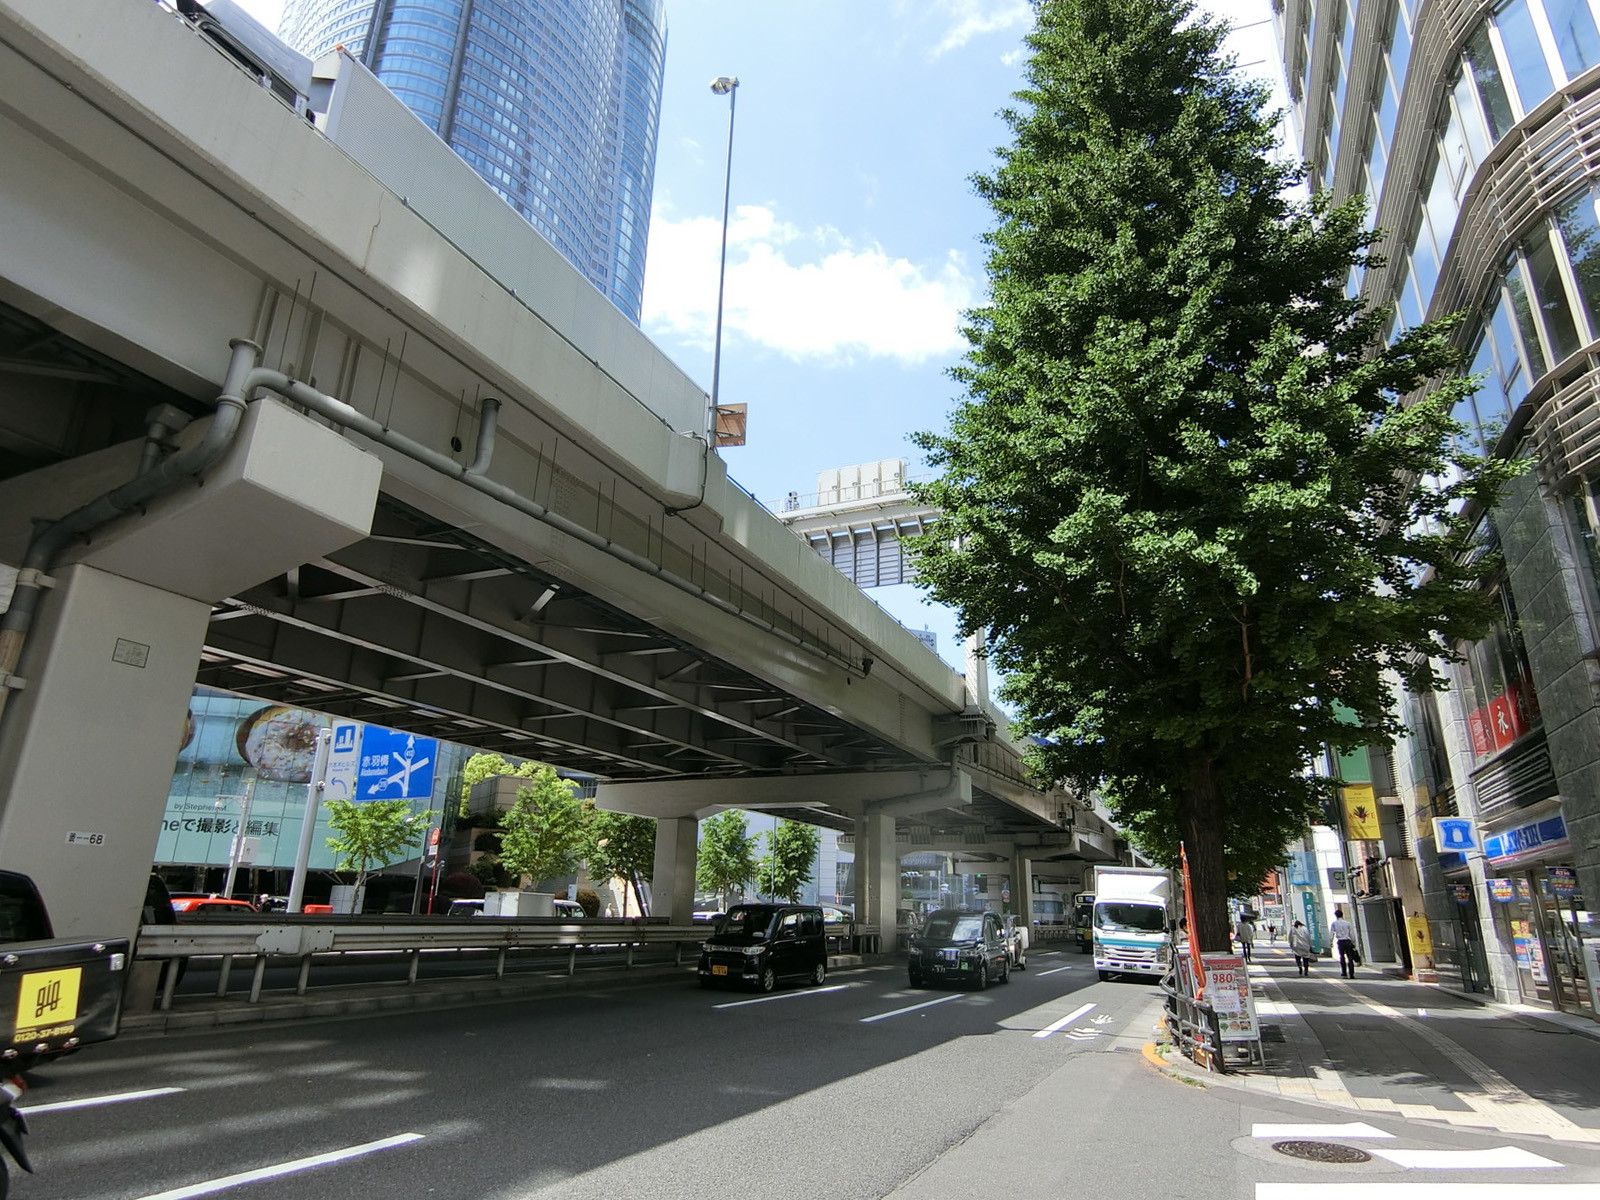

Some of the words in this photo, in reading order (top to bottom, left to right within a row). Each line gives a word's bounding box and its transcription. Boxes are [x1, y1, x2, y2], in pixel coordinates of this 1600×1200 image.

[362, 754, 389, 767] 赤羽橋
[174, 803, 183, 811] by
[1213, 973, 1232, 983] 980
